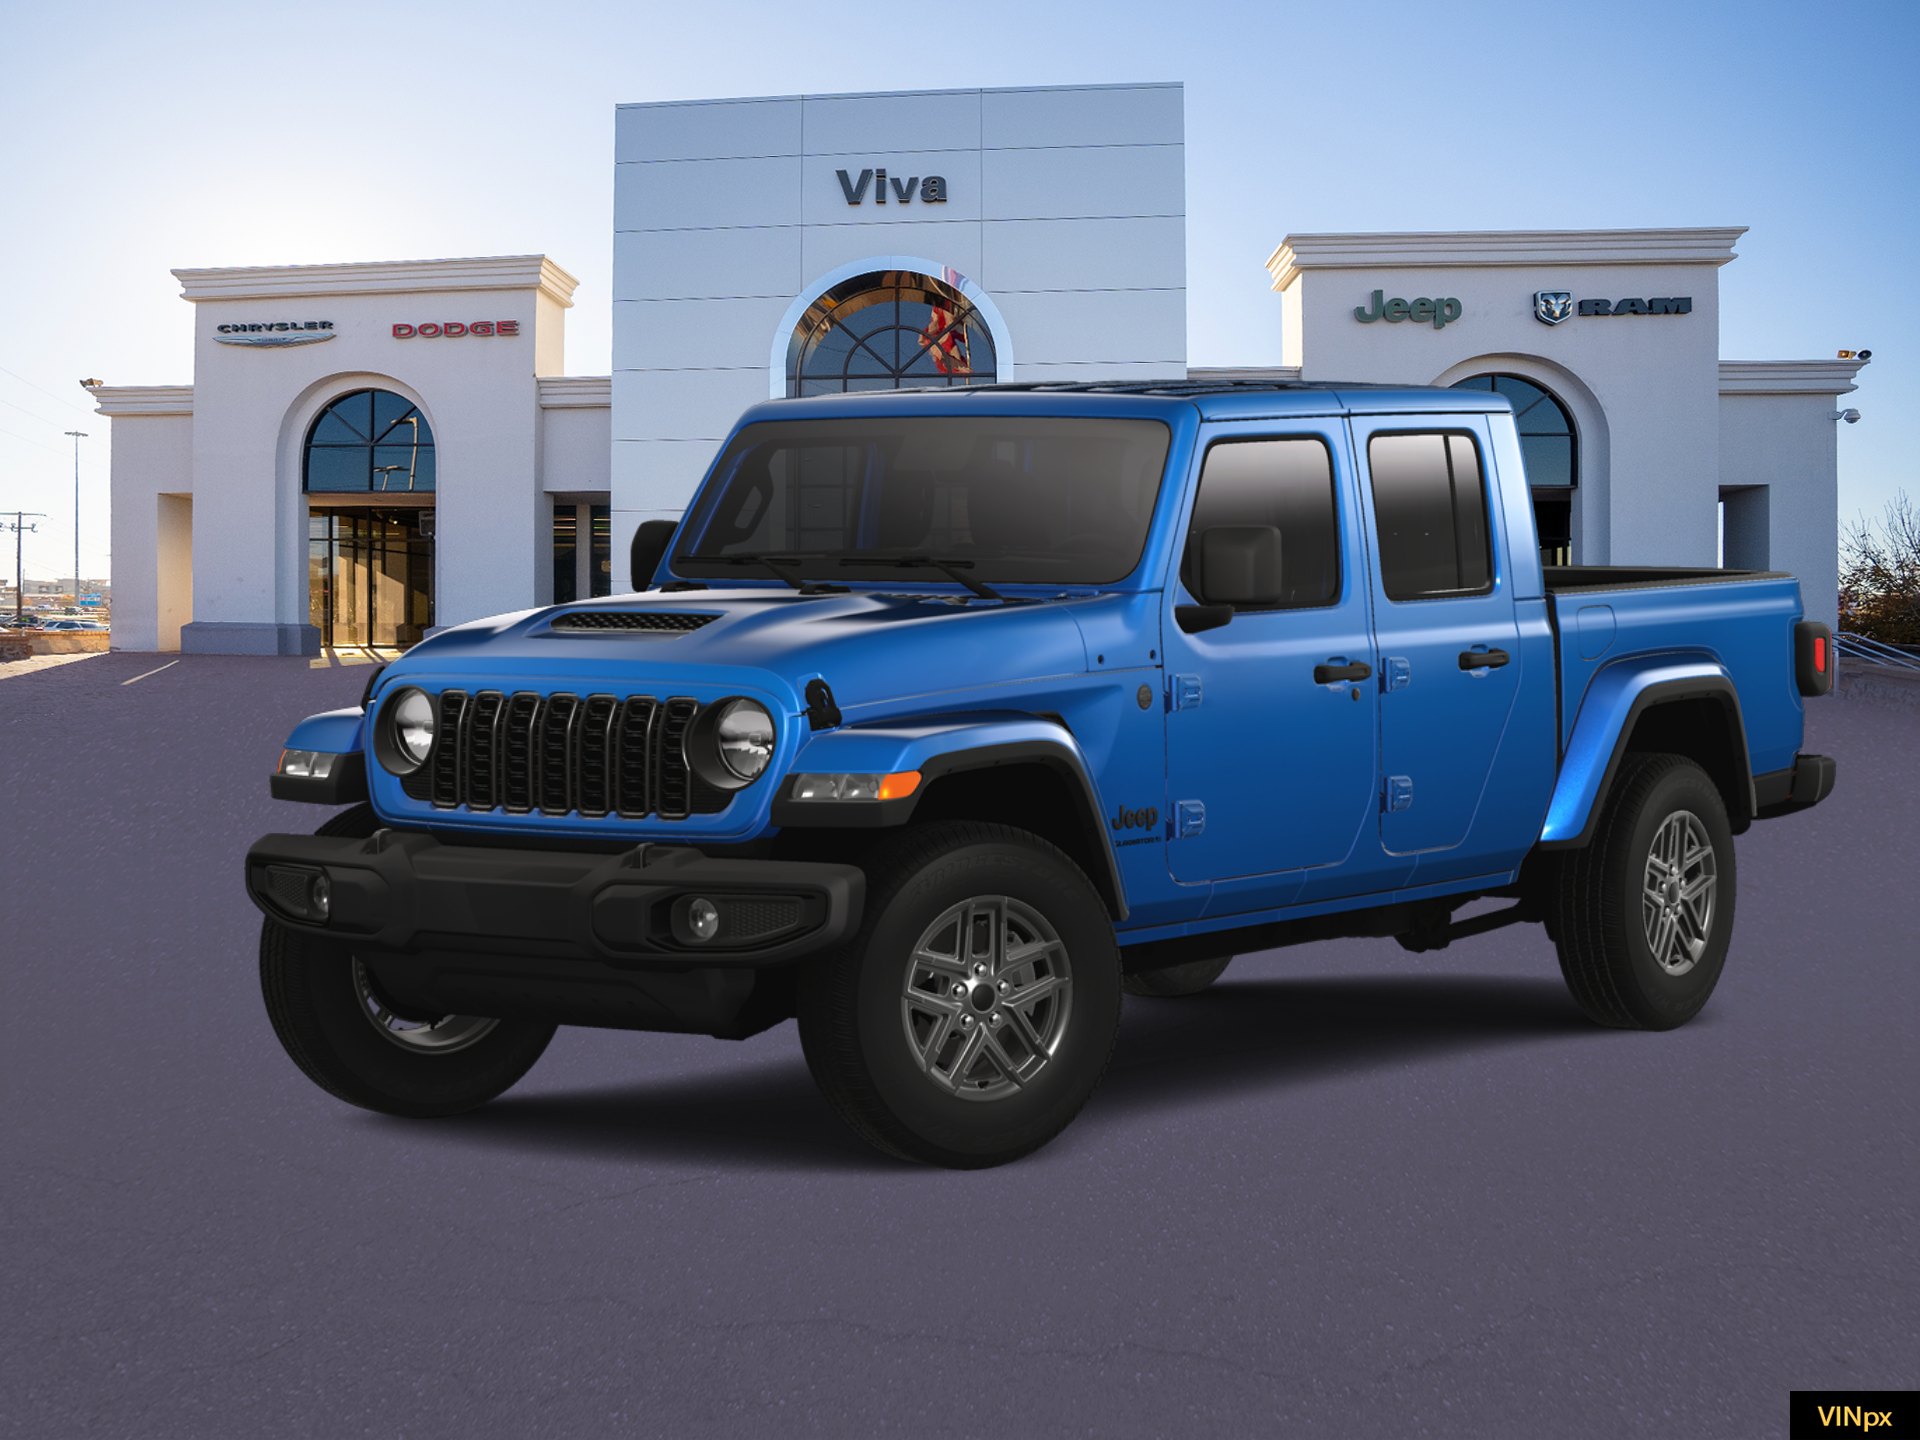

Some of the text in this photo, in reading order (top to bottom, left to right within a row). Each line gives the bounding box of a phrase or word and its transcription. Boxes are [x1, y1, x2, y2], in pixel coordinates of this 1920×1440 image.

[835, 168, 947, 205] Viva
[1354, 289, 1462, 329] Jeep
[1578, 297, 1692, 316] RAM
[217, 320, 334, 333] CHRYSLER
[392, 320, 519, 338] DODGE
[1112, 804, 1158, 831] Jeep
